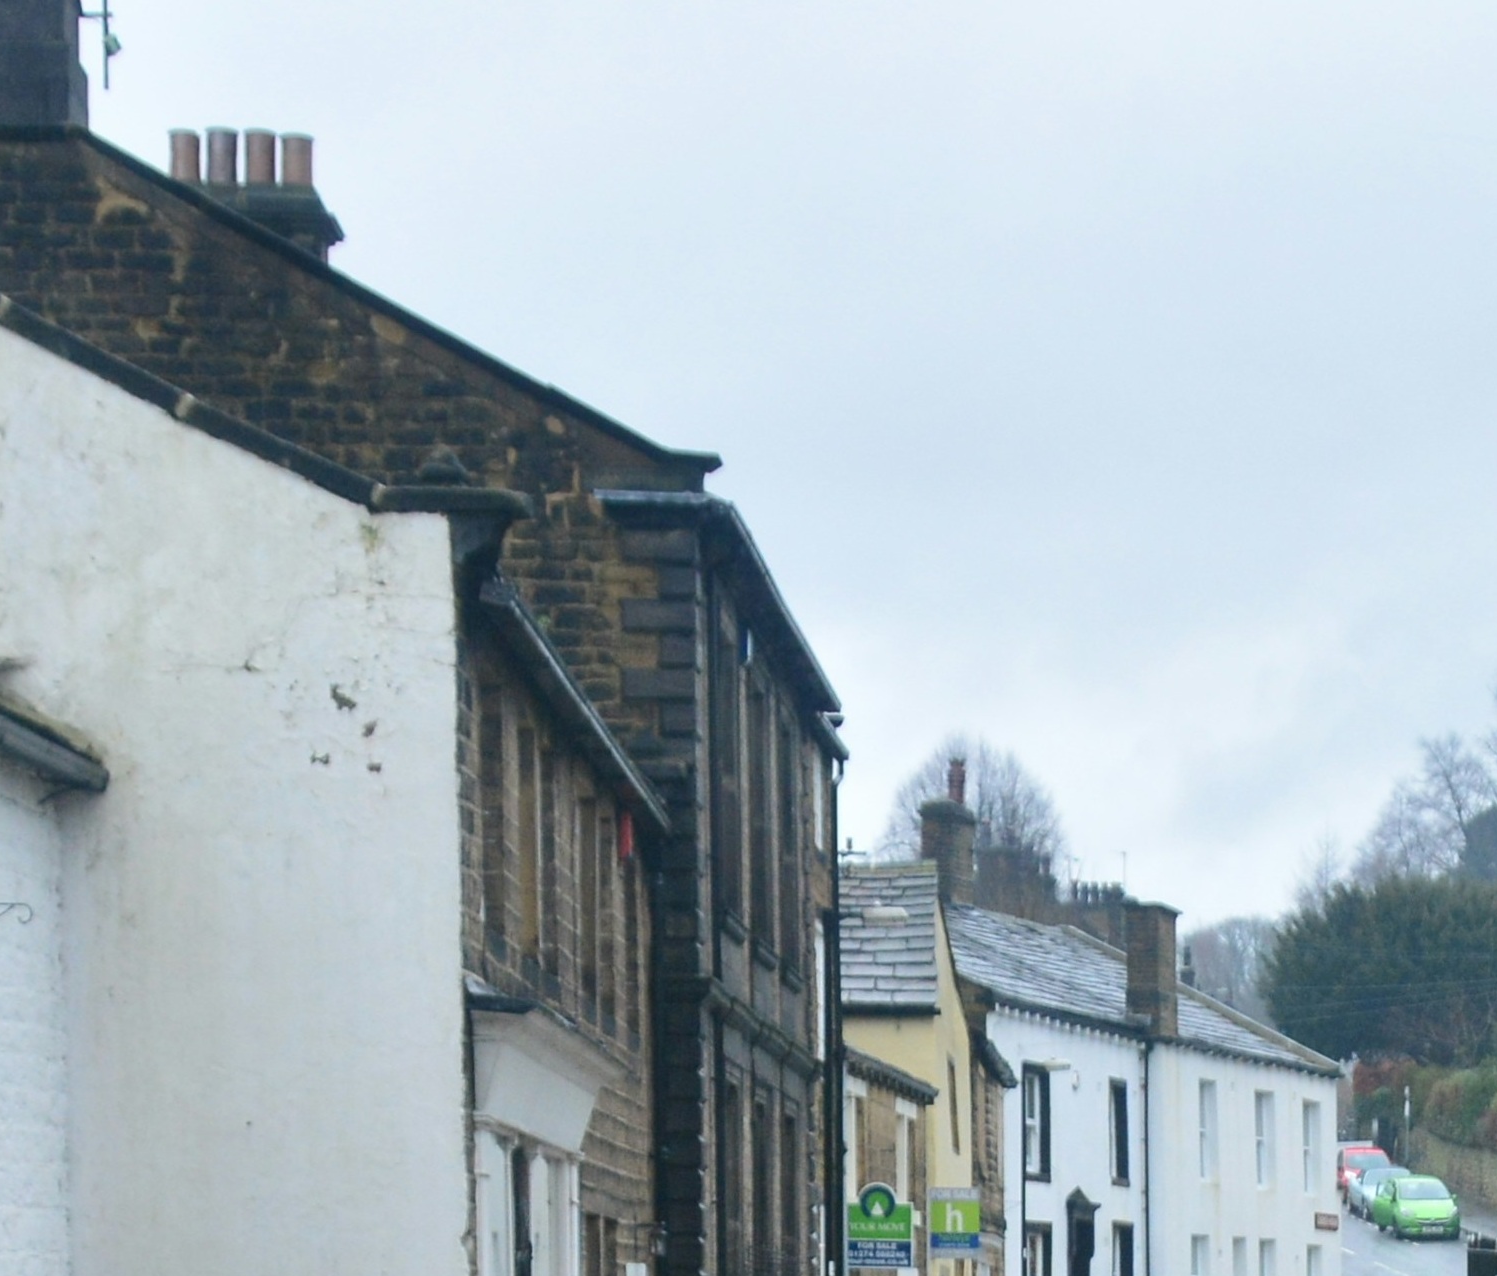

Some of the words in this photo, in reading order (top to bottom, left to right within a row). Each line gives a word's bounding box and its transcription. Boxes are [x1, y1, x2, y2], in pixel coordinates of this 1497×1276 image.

[945, 1202, 963, 1232] h
[848, 1221, 879, 1233] YOUR
[880, 1221, 905, 1232] MOVE
[857, 1241, 875, 1250] FOR
[876, 1241, 898, 1250] SALE
